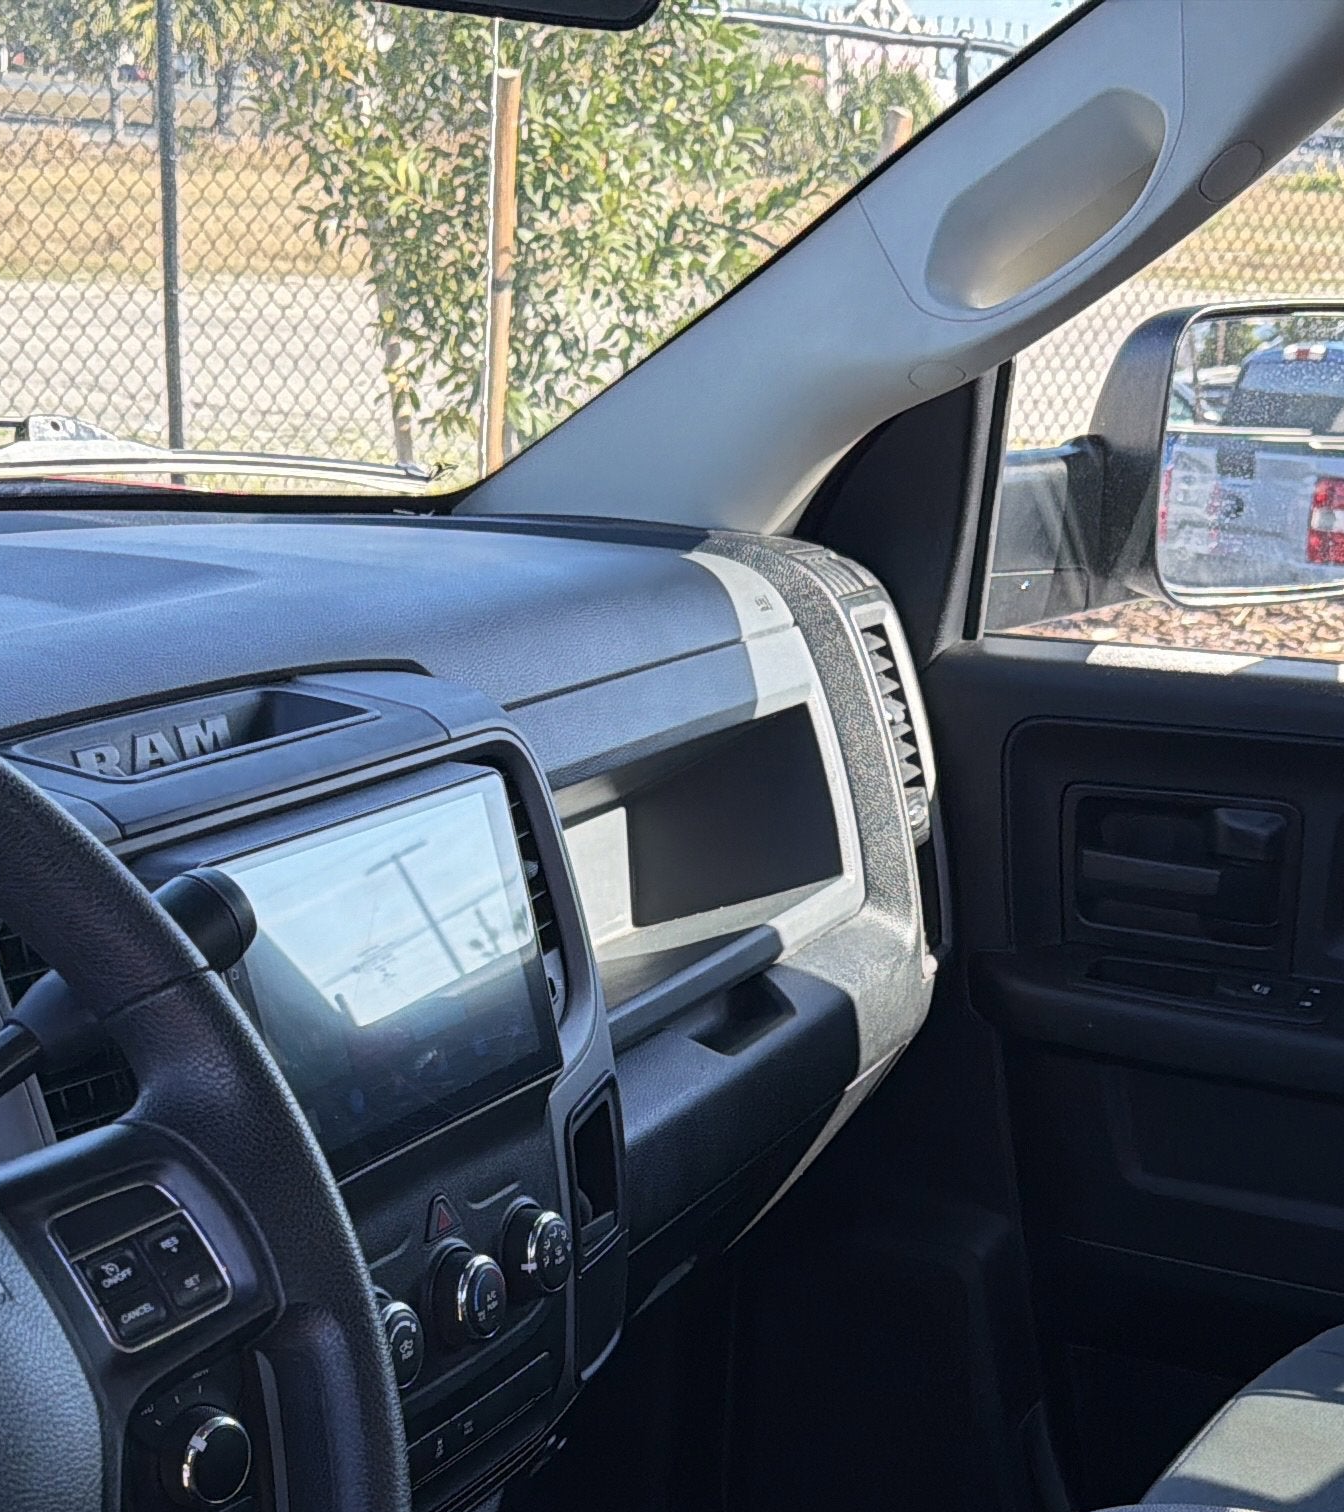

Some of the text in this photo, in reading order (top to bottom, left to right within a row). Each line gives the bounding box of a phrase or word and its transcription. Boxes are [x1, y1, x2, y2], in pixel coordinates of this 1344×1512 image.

[73, 714, 232, 778] RAM
[183, 1273, 202, 1289] SET
[120, 1302, 155, 1324] CANCEL
